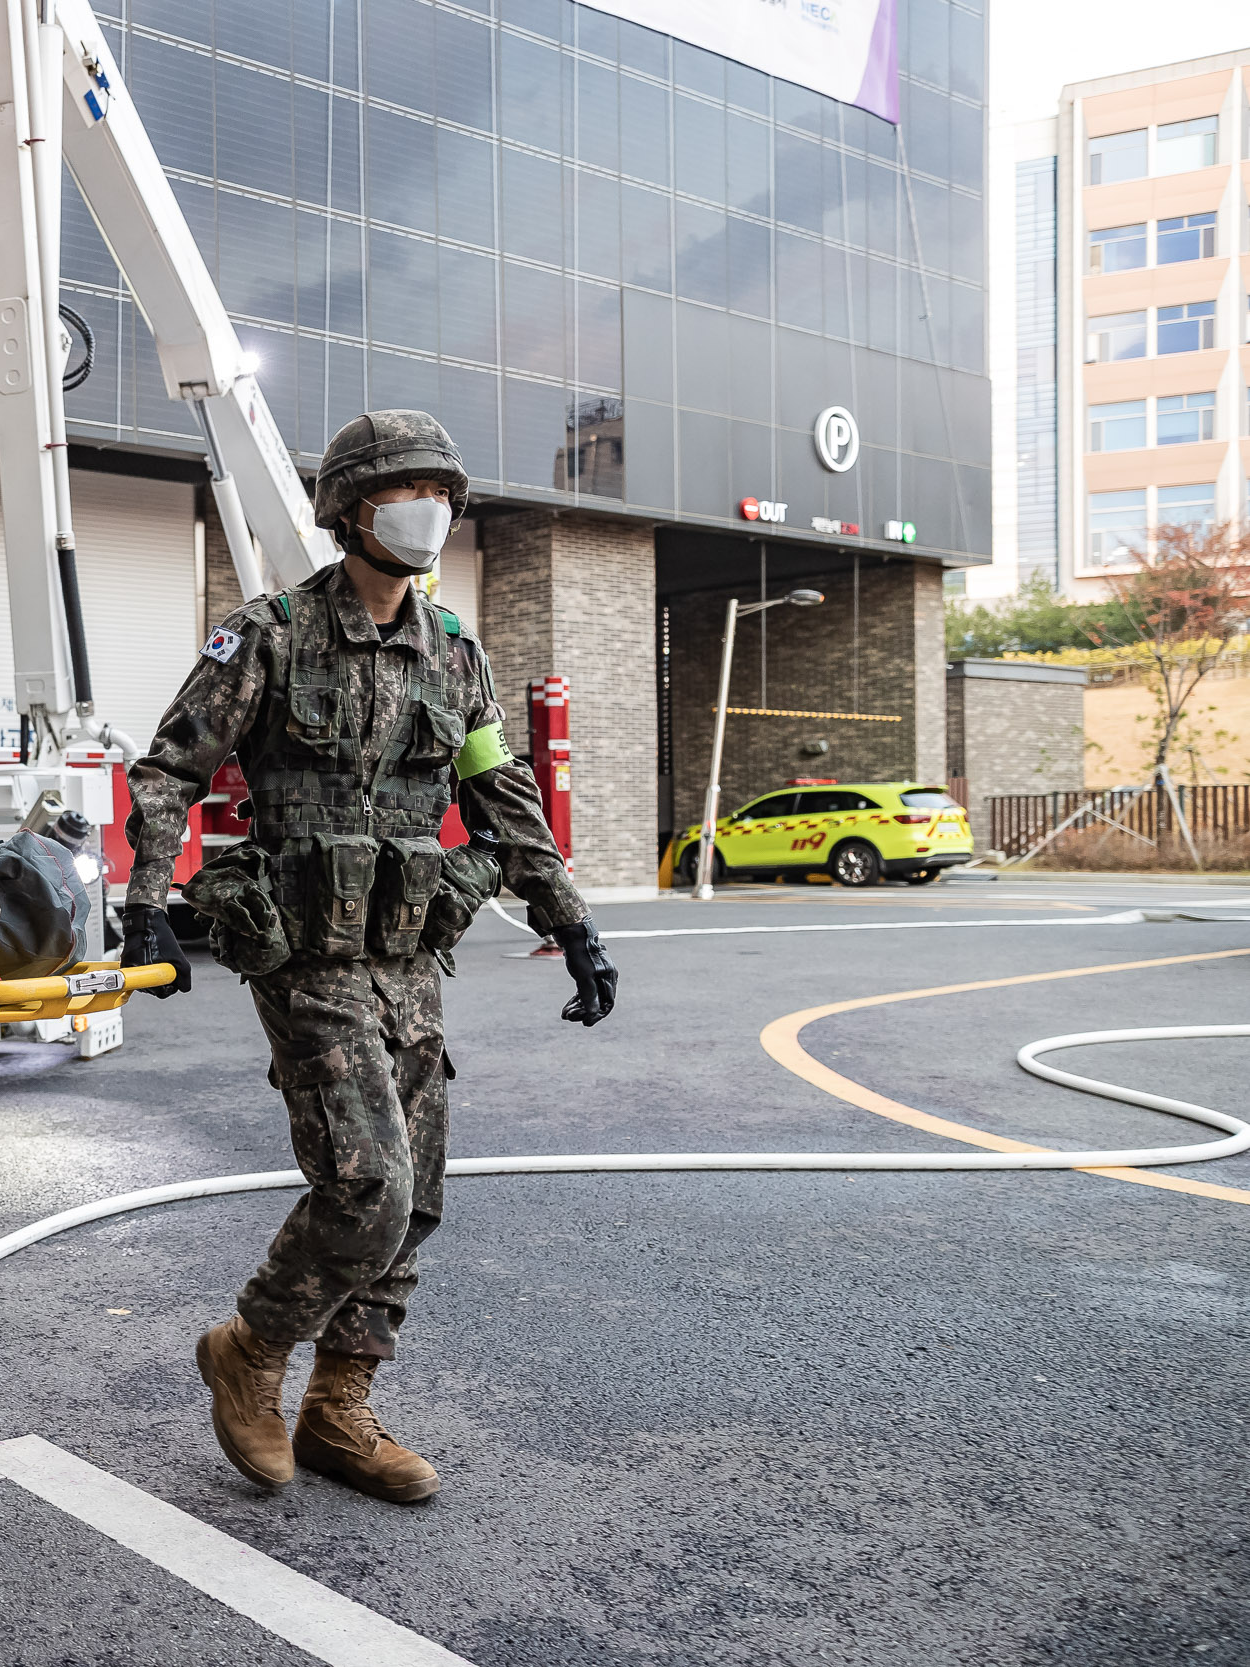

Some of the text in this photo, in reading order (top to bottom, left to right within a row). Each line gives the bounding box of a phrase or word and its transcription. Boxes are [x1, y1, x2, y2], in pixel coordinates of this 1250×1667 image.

[830, 416, 851, 459] P
[759, 500, 788, 522] OUT
[884, 520, 903, 541] IN
[791, 831, 827, 850] 119
